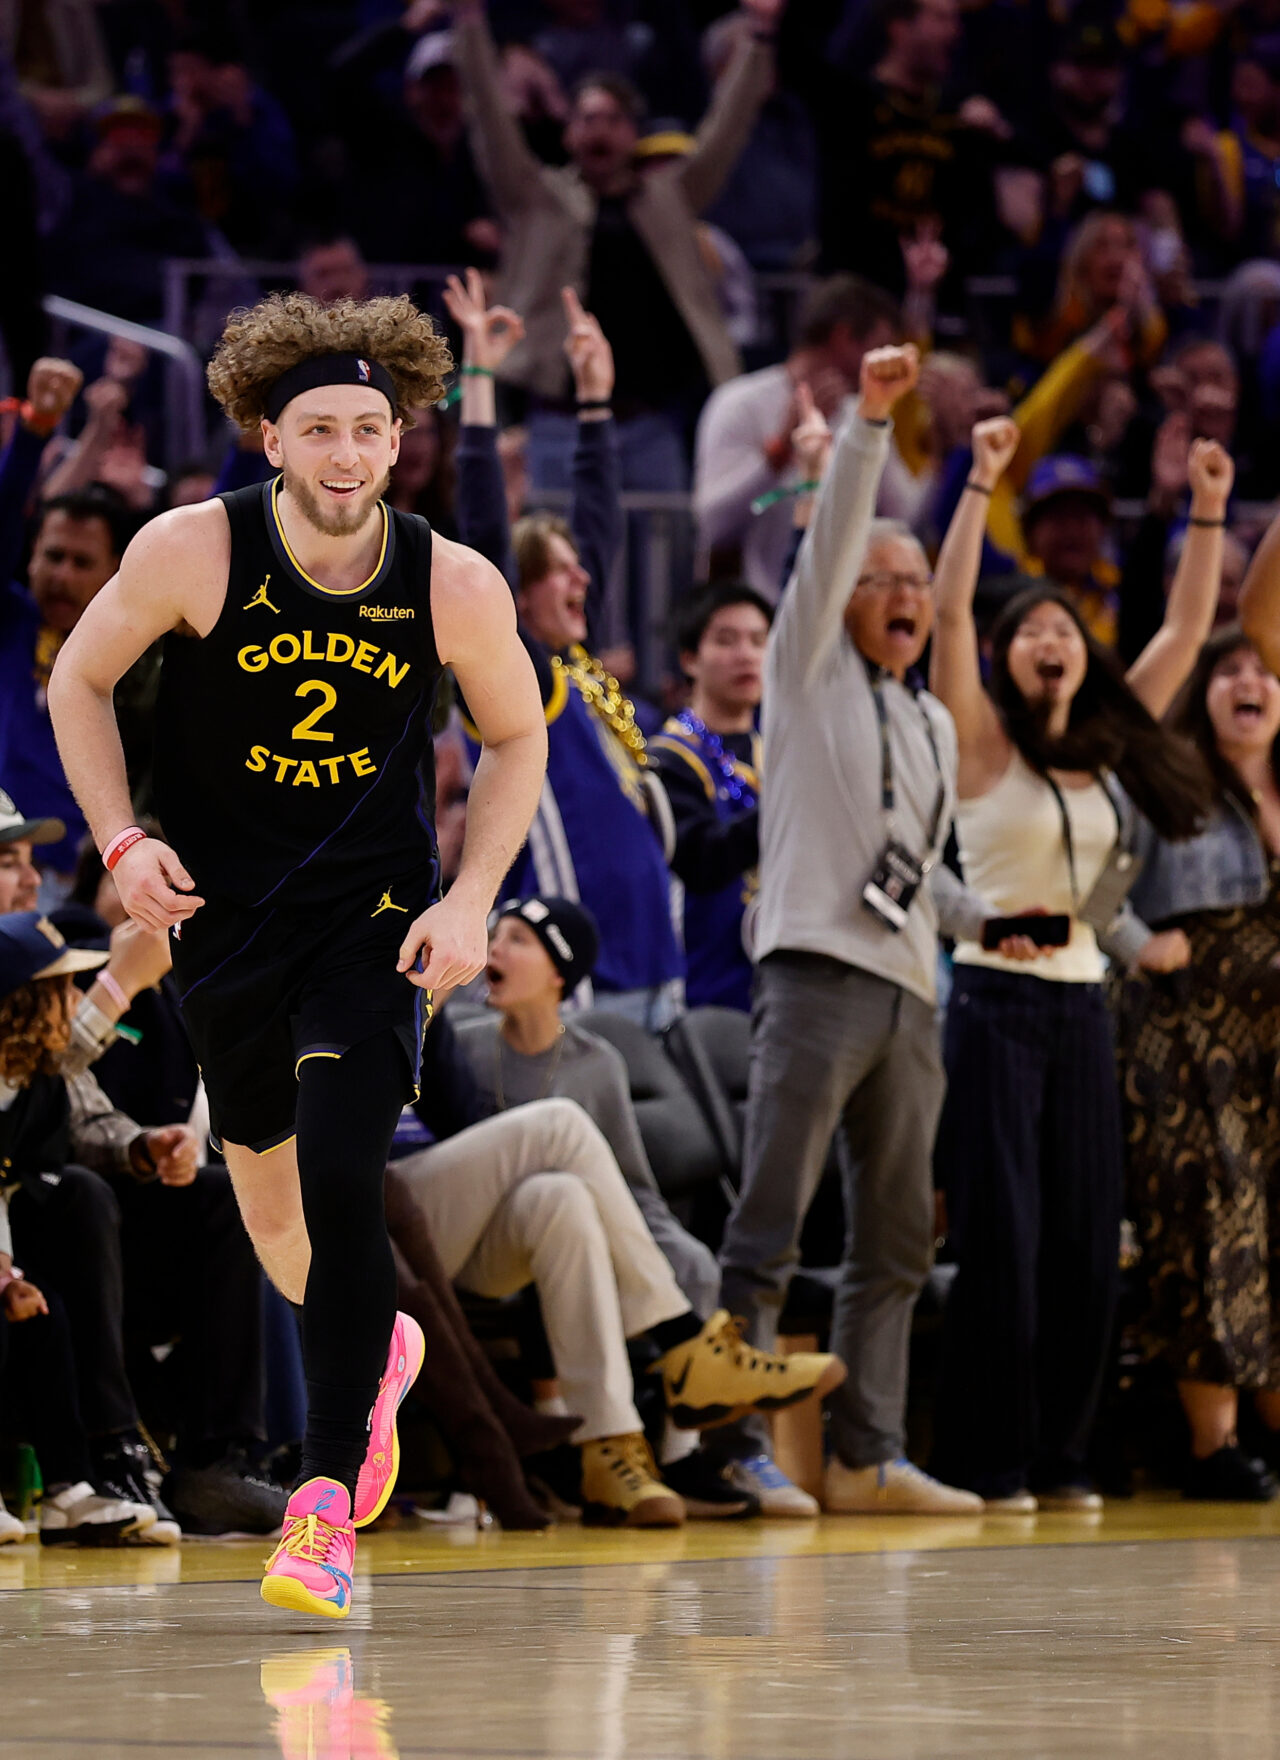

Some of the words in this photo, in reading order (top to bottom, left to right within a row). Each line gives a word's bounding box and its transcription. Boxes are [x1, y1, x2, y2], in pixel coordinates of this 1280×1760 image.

[359, 604, 415, 620] Rakuten
[237, 630, 411, 689] GOLDEN
[292, 679, 337, 742] 2
[245, 745, 377, 788] STATE
